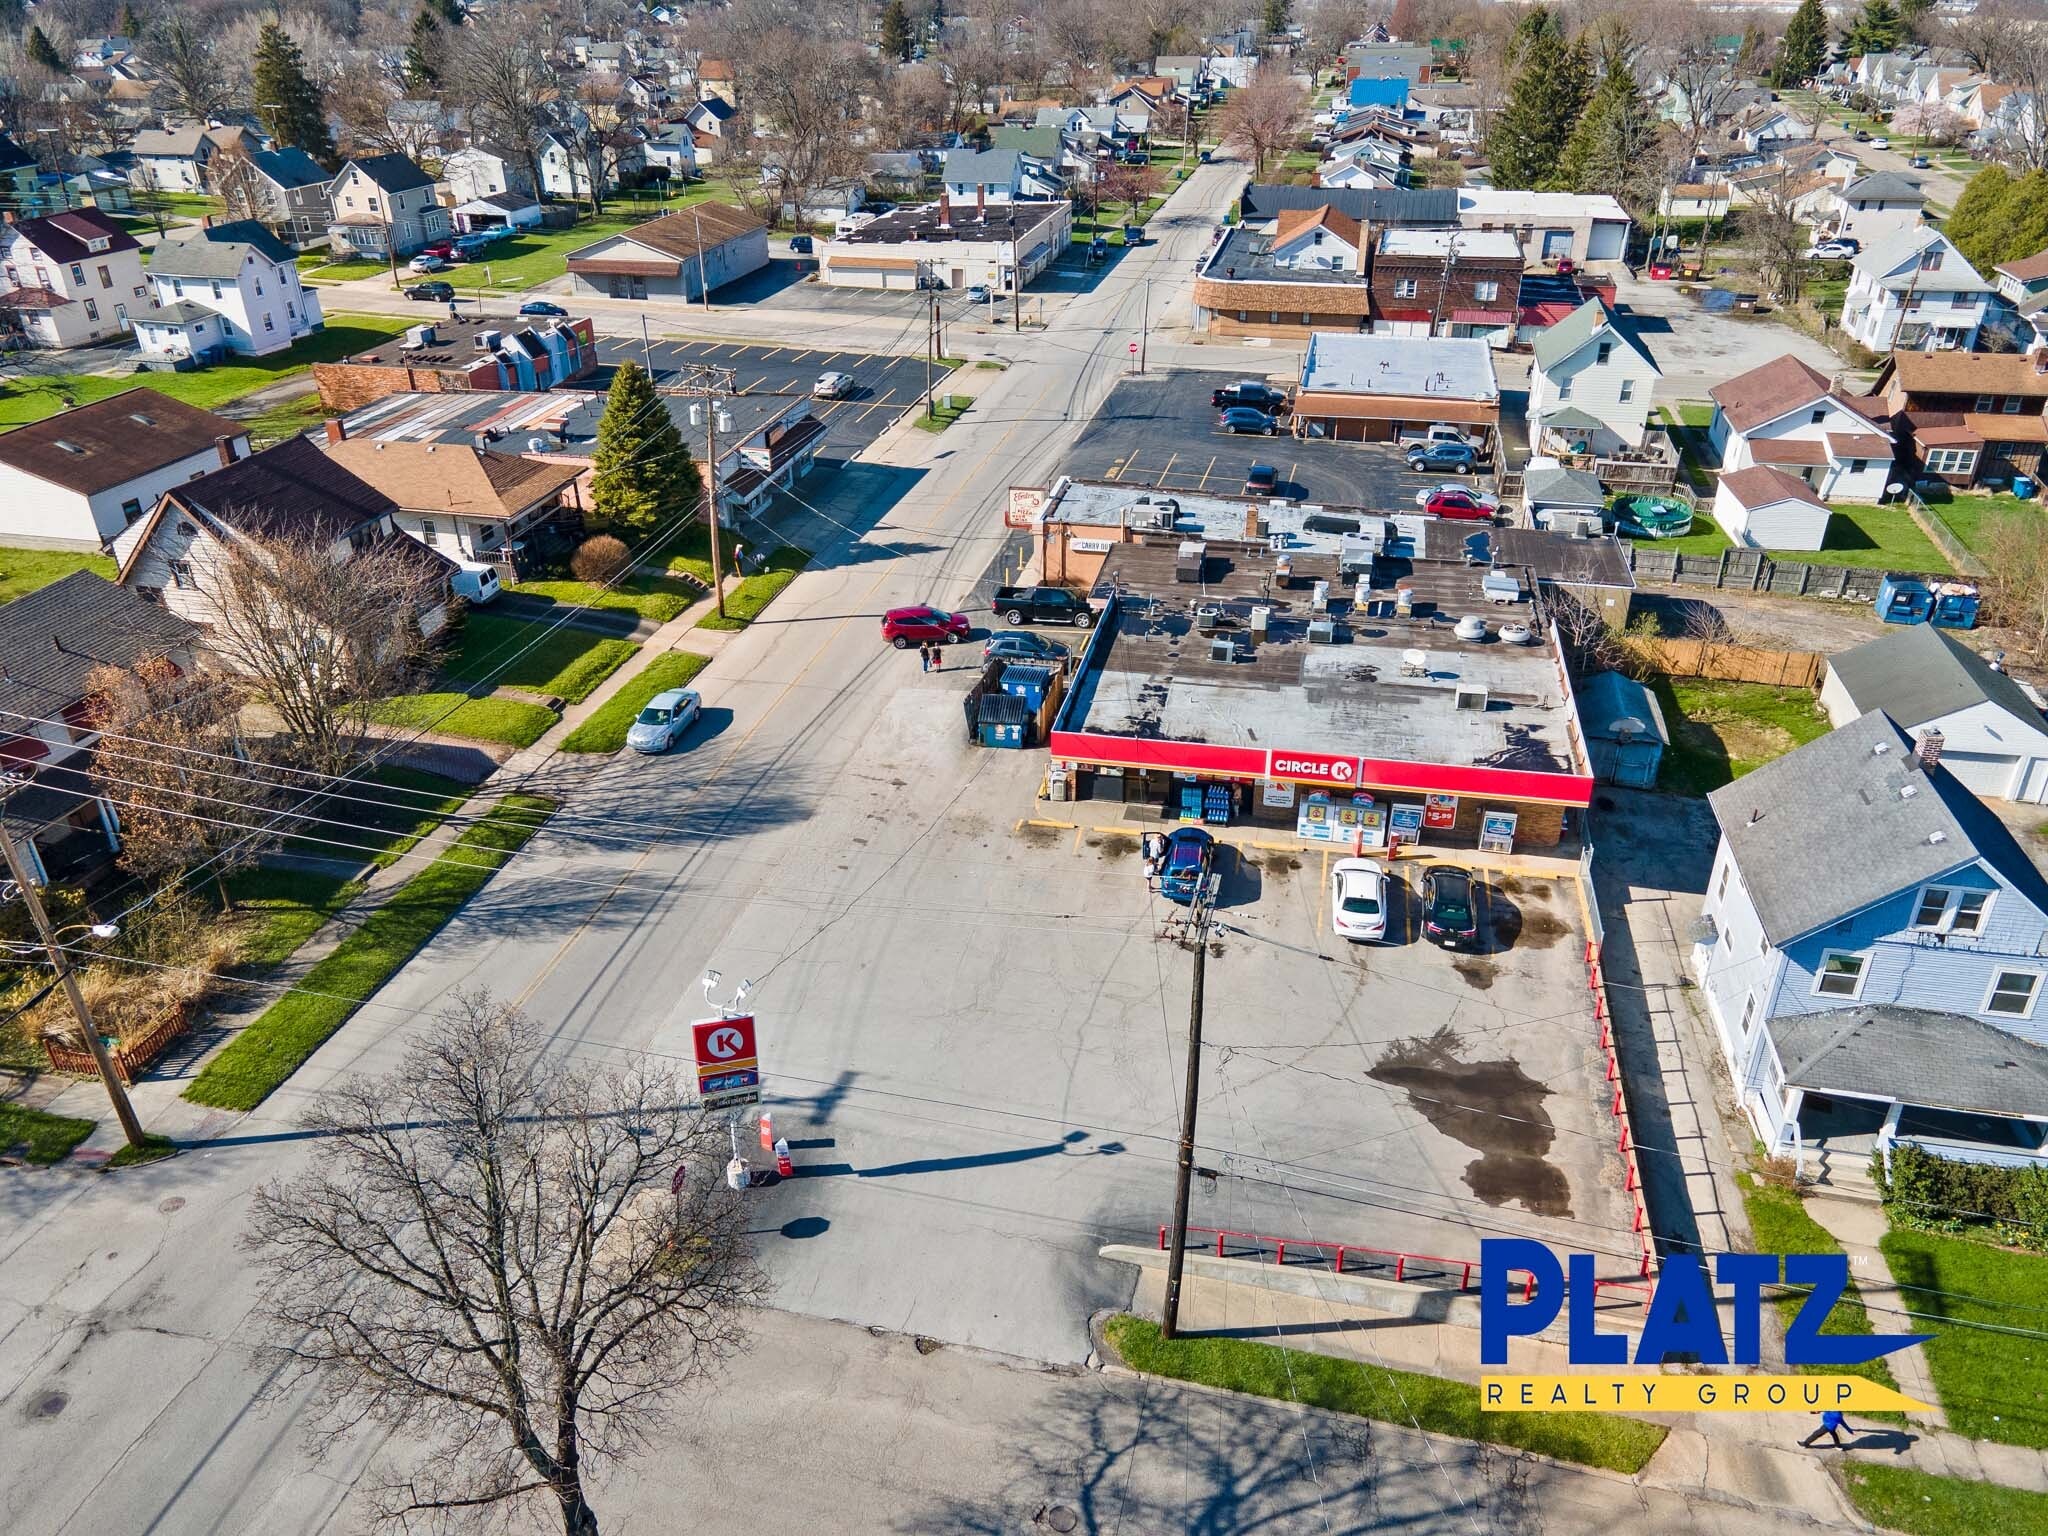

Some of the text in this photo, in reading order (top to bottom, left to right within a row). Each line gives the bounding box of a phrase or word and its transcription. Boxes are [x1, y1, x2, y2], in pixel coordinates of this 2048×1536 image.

[1275, 759, 1351, 780] CIRCLE K
[713, 1030, 742, 1055] K
